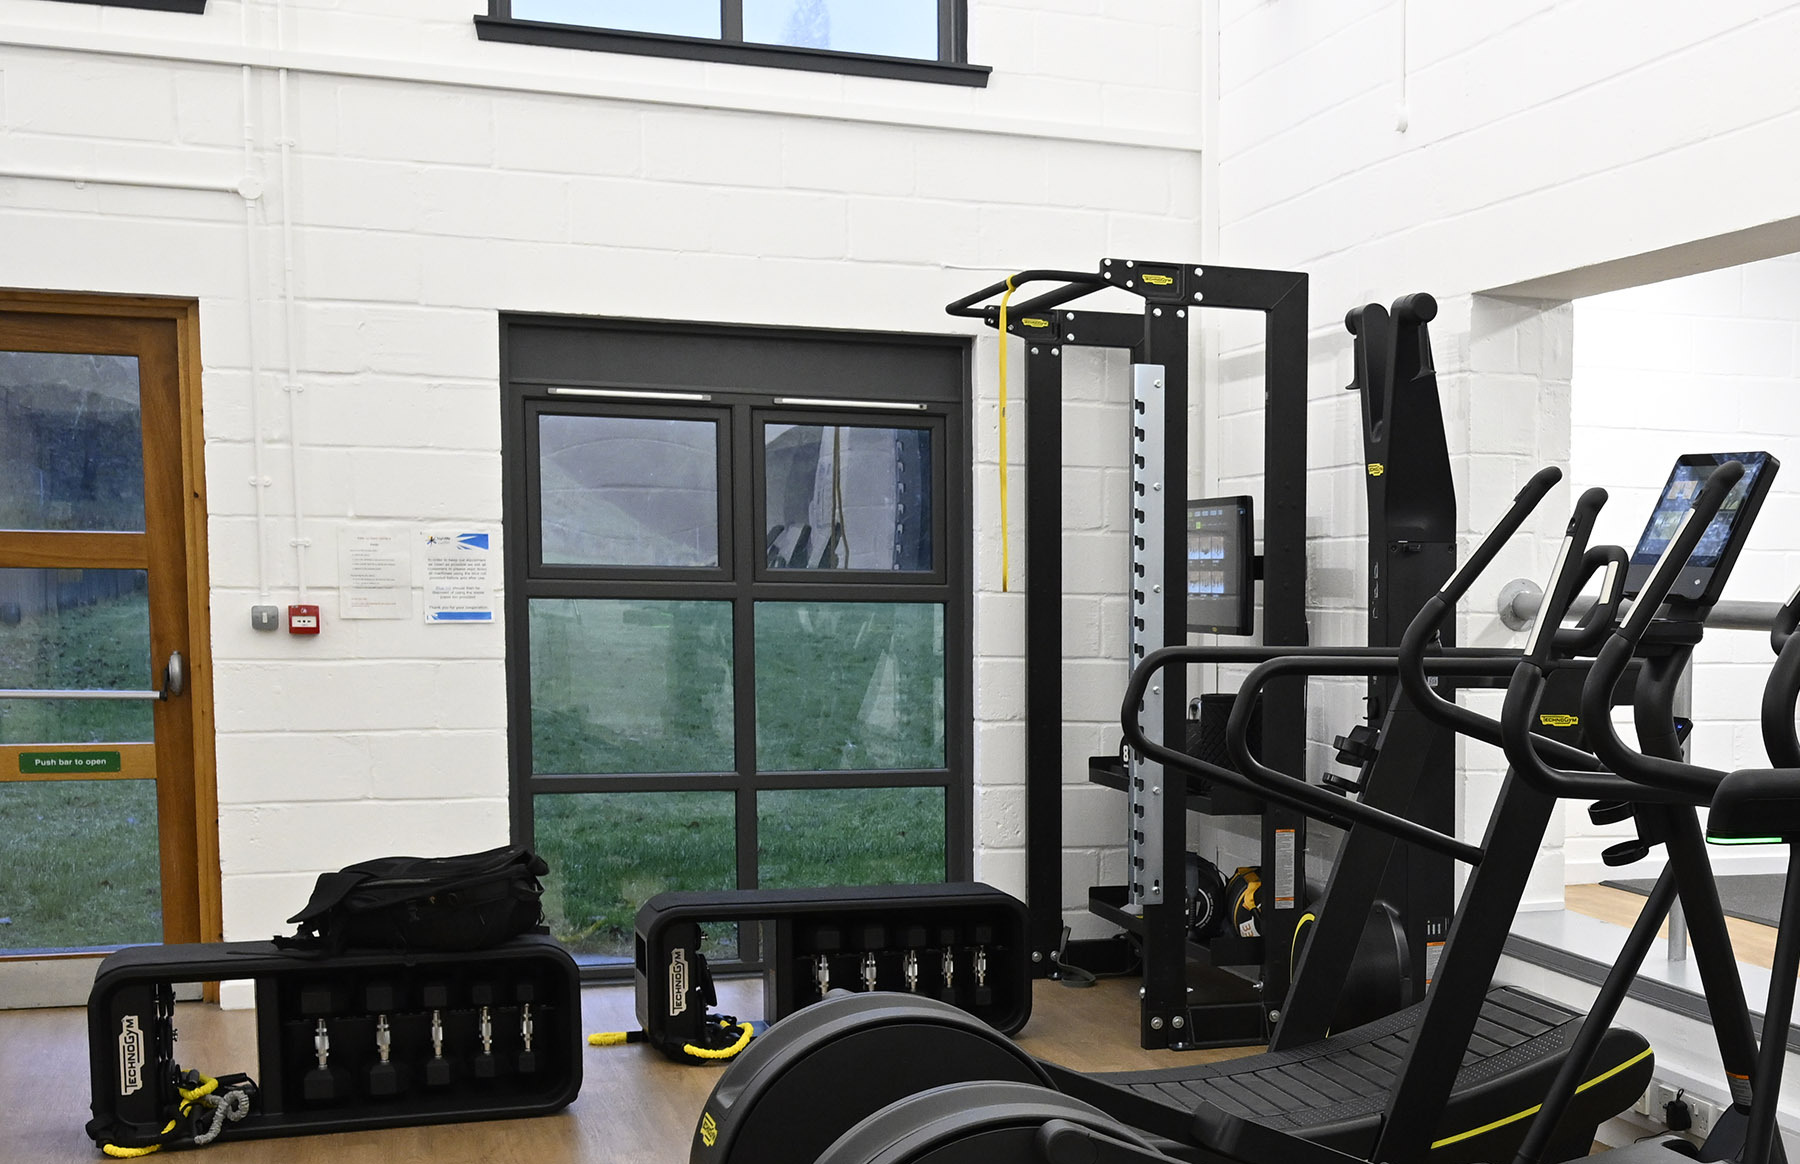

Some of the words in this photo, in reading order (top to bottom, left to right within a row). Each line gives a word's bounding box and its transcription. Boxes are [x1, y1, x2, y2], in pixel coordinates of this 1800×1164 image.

[85, 759, 106, 767] open
[672, 951, 686, 1014] TECHNOGYM
[123, 1019, 140, 1093] TECHNOGYM
